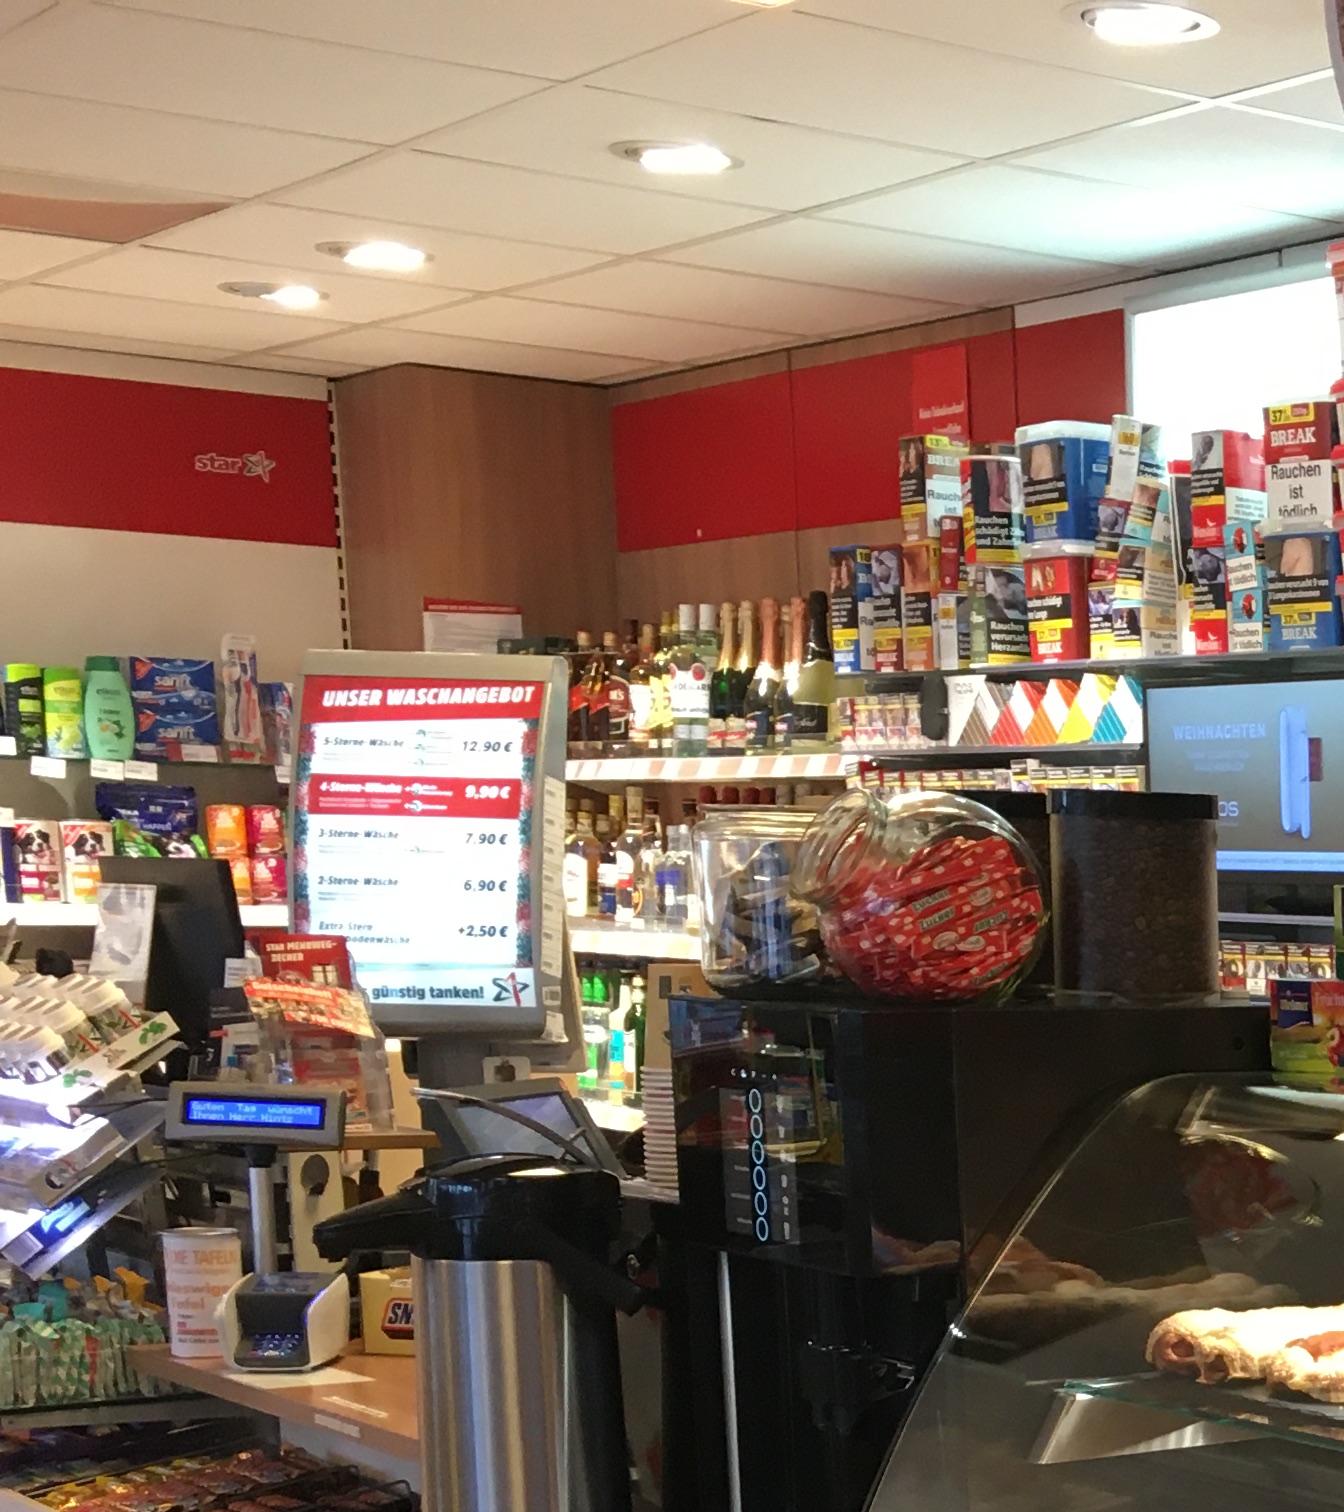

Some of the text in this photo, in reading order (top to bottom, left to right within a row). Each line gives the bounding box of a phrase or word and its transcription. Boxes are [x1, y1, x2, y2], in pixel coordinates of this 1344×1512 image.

[1270, 427, 1316, 447] BREAK
[195, 452, 241, 474] star
[927, 454, 959, 465] BREA
[1271, 464, 1321, 480] Rauchen
[927, 490, 961, 500] Rauch
[1289, 484, 1304, 500] ist
[1278, 504, 1317, 517] tödlich
[1282, 626, 1317, 640] BREAK
[154, 673, 191, 687] sanft
[322, 686, 535, 707] UNSER WASCHANGEBOT
[157, 726, 194, 738] sanft
[1173, 723, 1266, 740] WEIHNACHTEN
[372, 985, 484, 1000] günstig tanken!
